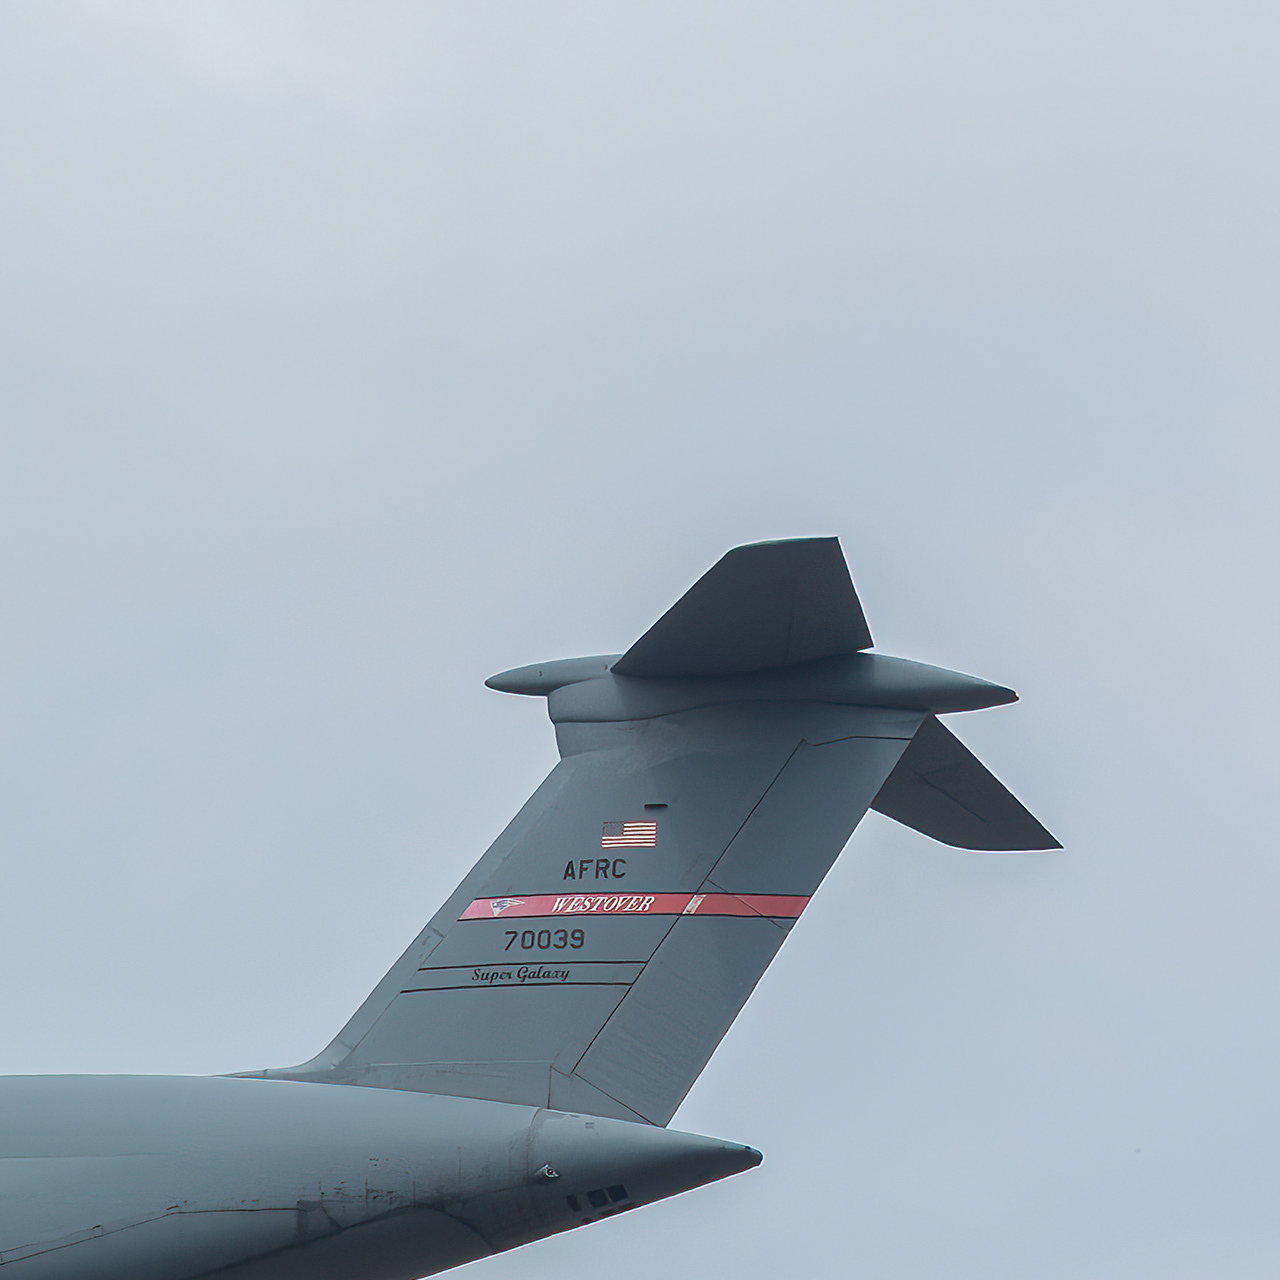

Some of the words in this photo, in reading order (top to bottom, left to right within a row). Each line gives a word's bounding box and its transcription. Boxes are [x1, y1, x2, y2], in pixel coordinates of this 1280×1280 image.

[563, 858, 627, 880] AFRC
[551, 896, 656, 914] WESTOVER
[504, 929, 586, 951] 70039
[471, 968, 512, 984] Super
[517, 965, 570, 983] Galaxy
